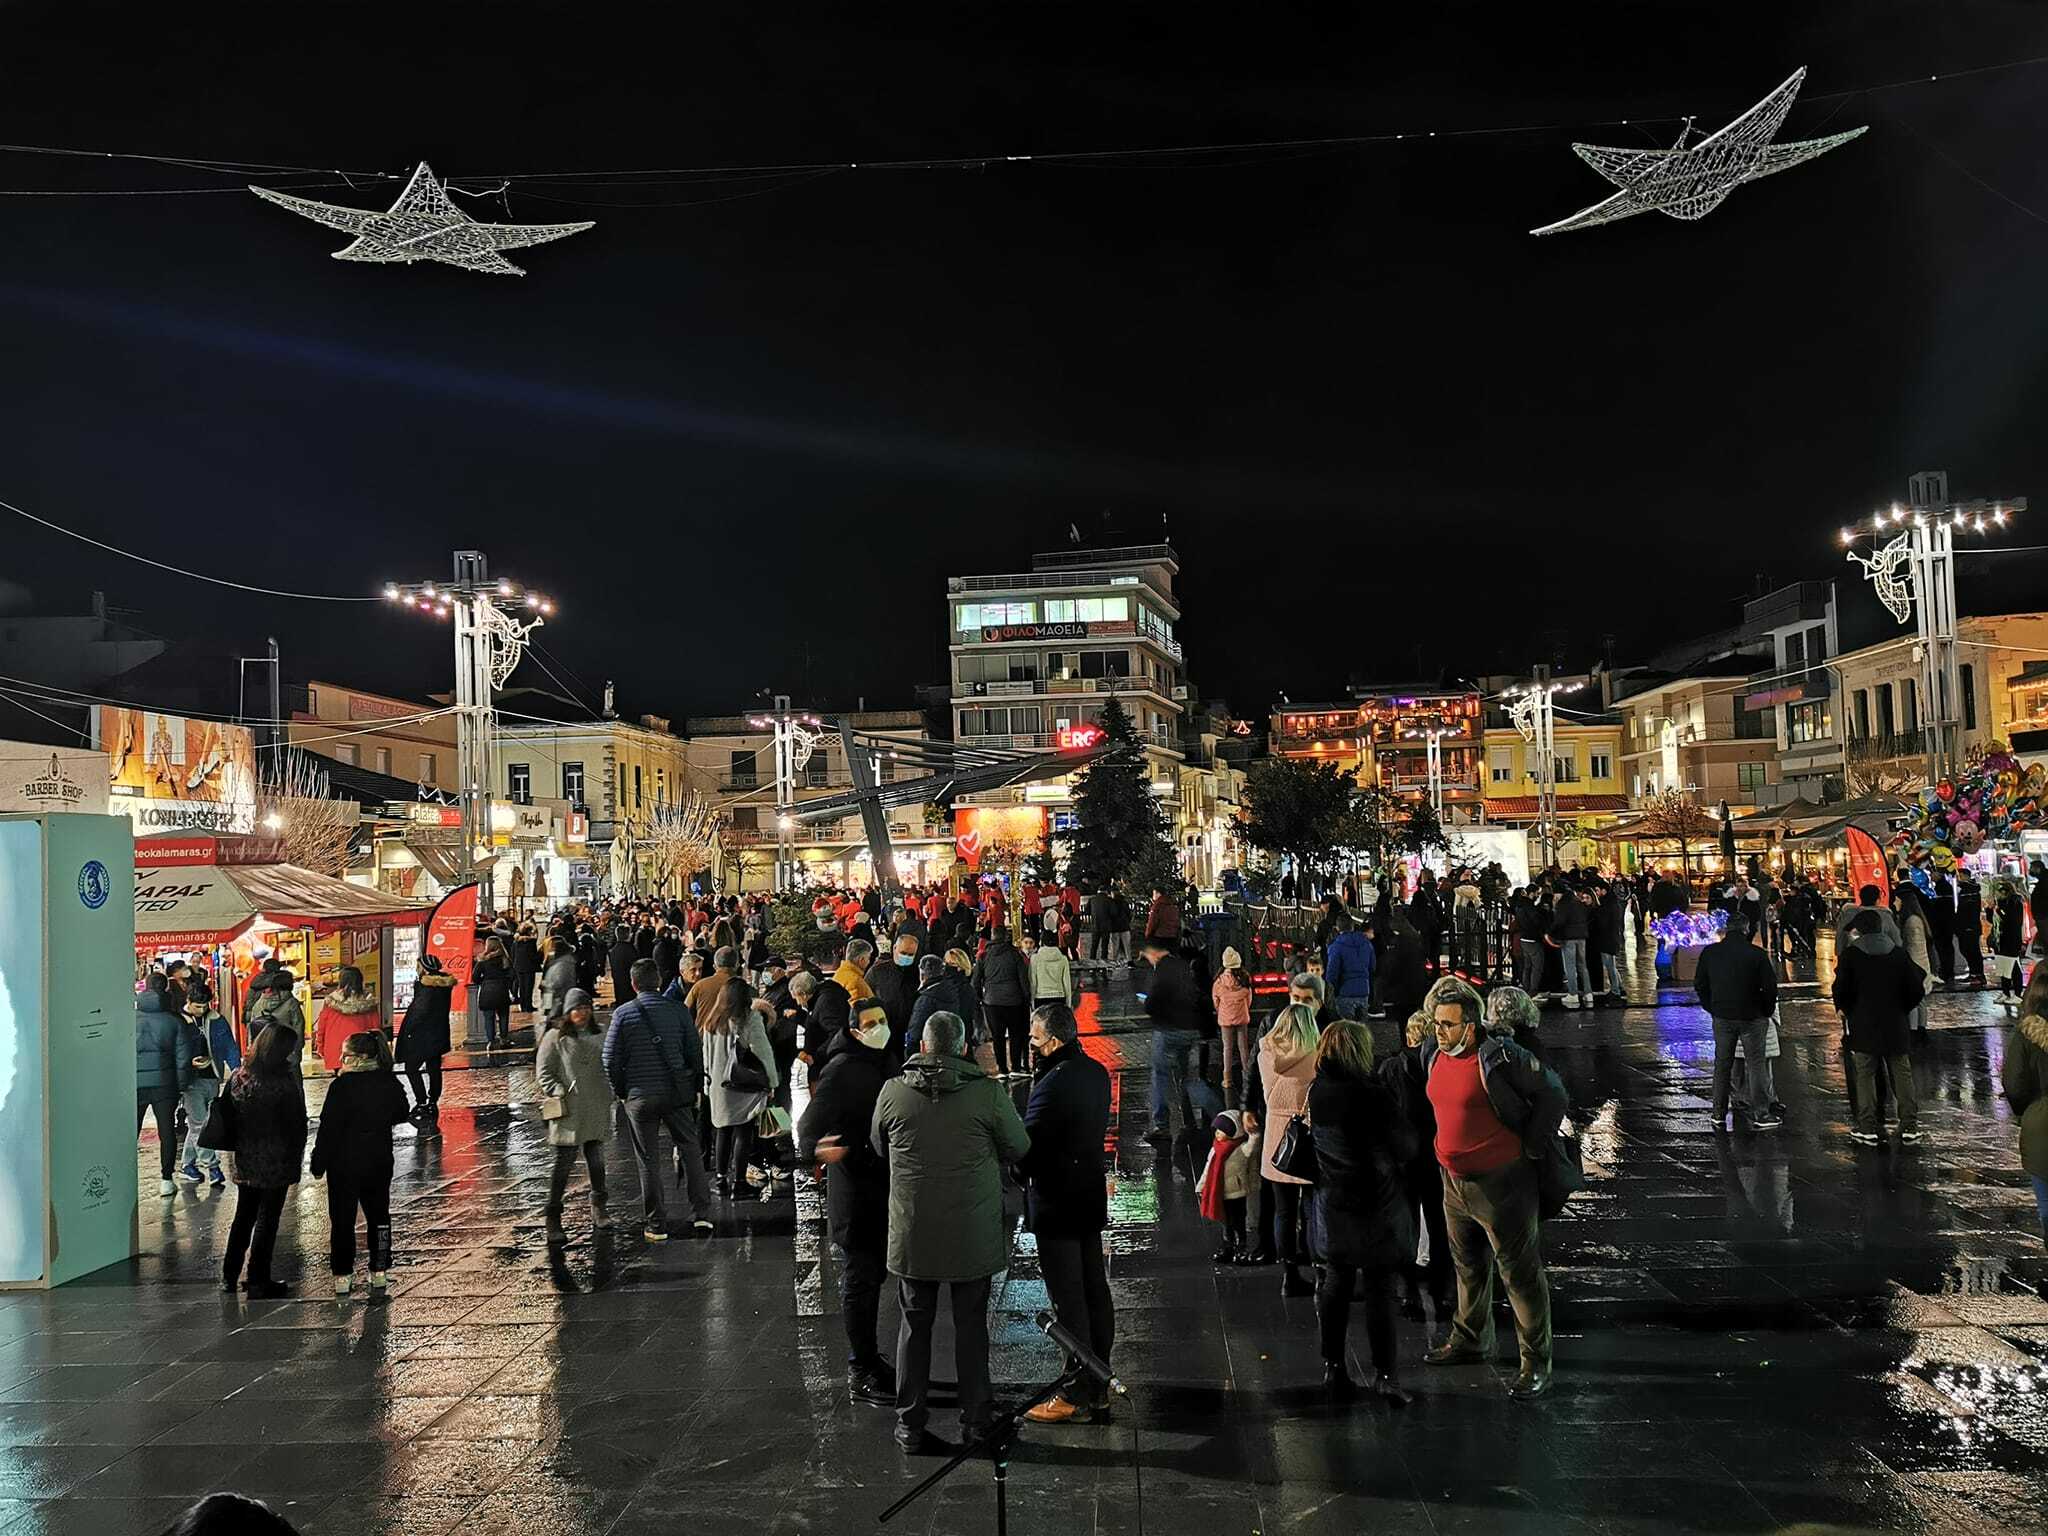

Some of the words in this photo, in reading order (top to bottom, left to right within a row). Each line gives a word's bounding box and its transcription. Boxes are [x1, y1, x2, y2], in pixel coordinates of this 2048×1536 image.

[1002, 624, 1085, 638] ΦΙΛΟΜΑΘΕΙΑ
[1061, 730, 1105, 748] ERG
[25, 783, 59, 796] BARBER
[62, 785, 84, 798] SHOP
[135, 900, 179, 912] ΤΕΟ
